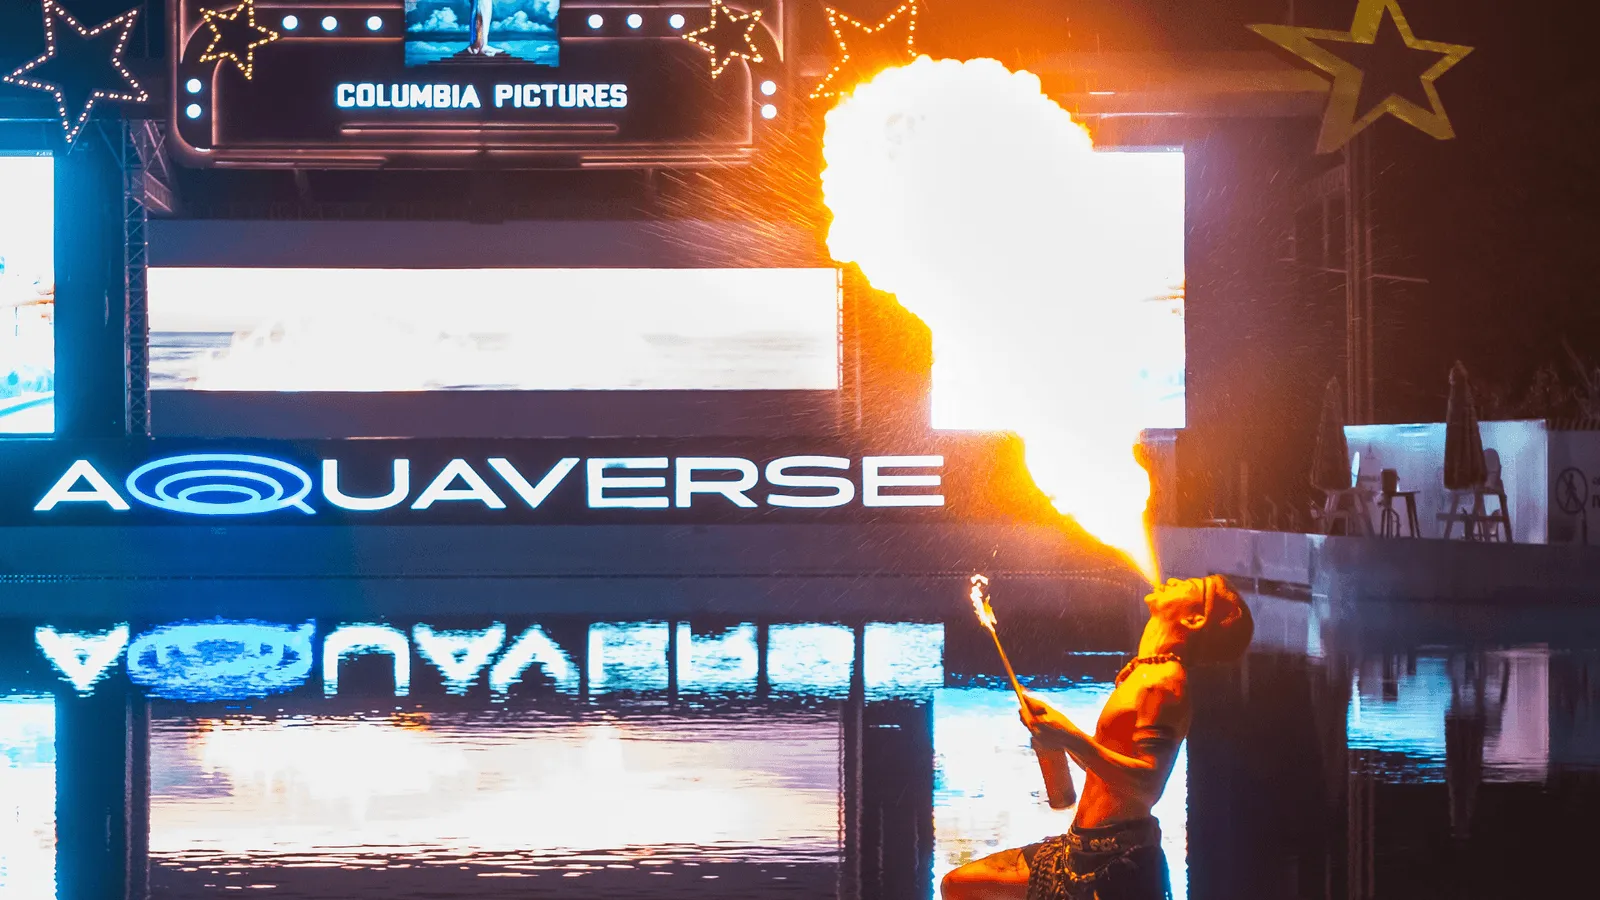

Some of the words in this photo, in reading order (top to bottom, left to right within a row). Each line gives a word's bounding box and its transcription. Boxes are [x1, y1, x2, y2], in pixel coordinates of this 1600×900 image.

[336, 83, 481, 108] COLUMBIA
[494, 83, 628, 108] PICTURES
[33, 453, 945, 515] AQUAVERSE
